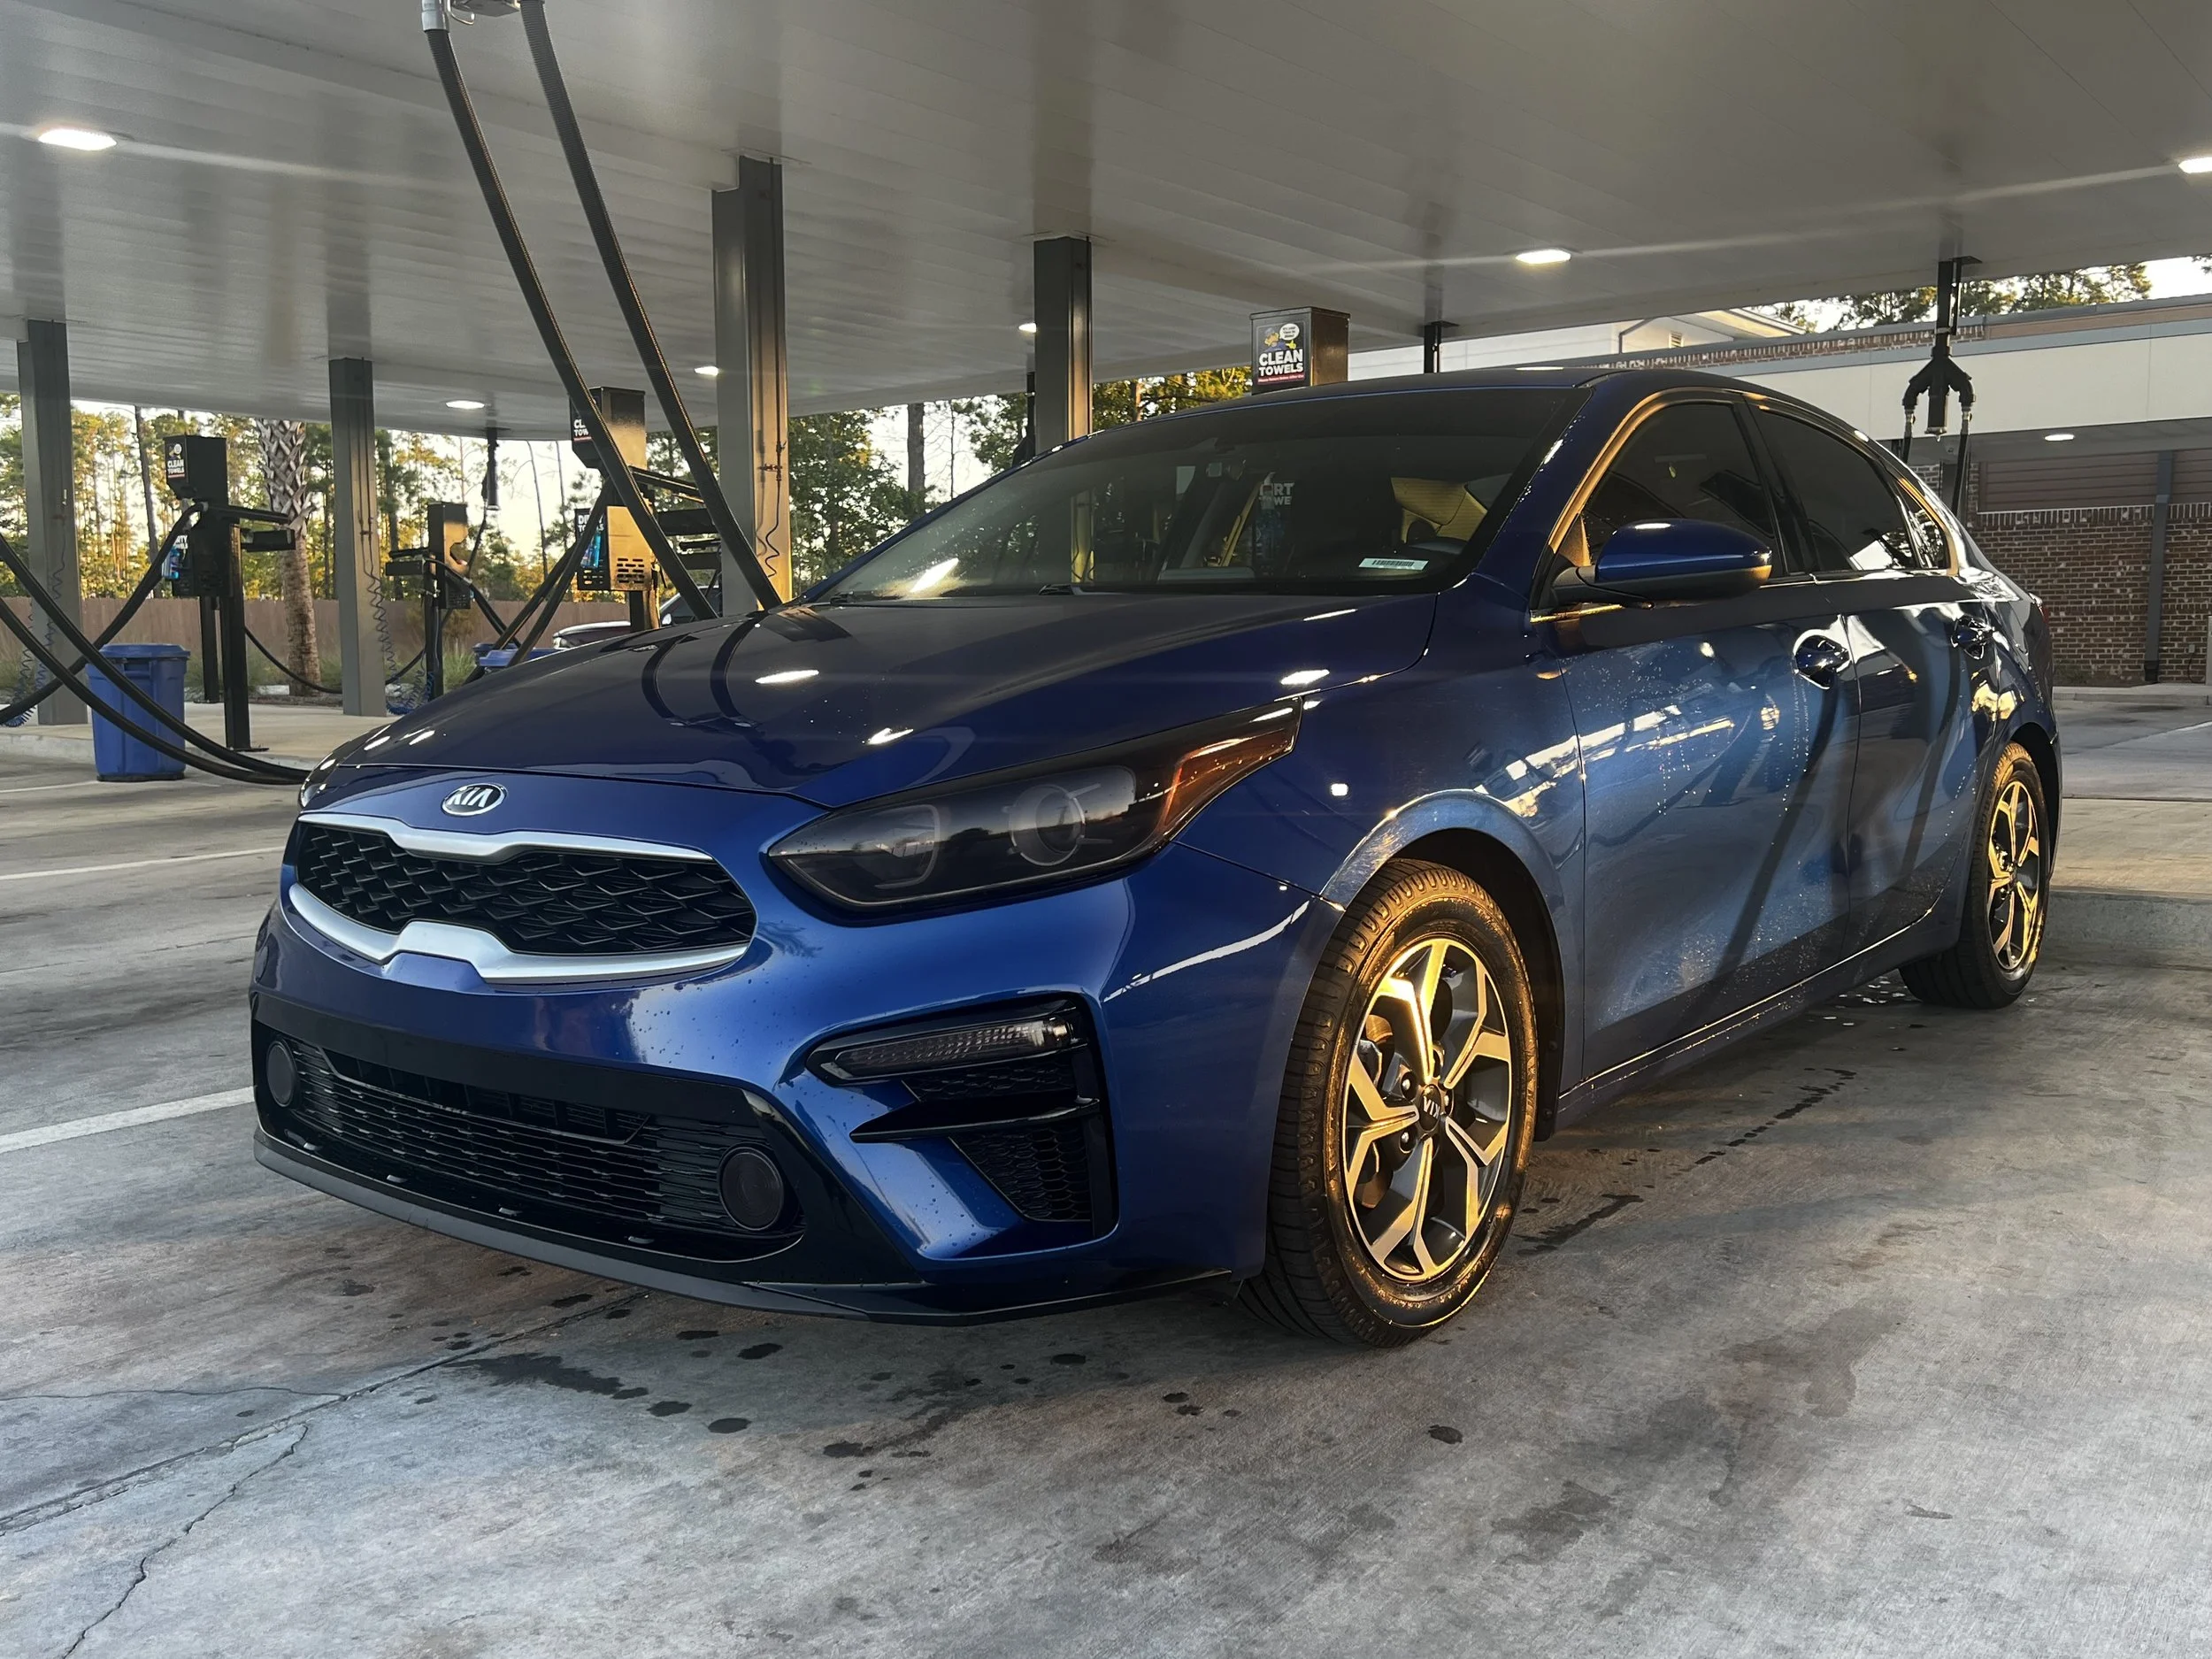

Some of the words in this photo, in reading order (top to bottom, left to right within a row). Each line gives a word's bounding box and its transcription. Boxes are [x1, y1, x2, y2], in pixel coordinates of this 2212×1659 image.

[1259, 349, 1303, 366] CLEAN
[1259, 363, 1304, 377] TOWELS
[167, 459, 184, 468] CLEAN
[446, 787, 493, 808] KIA
[1424, 1096, 1440, 1119] KIA
